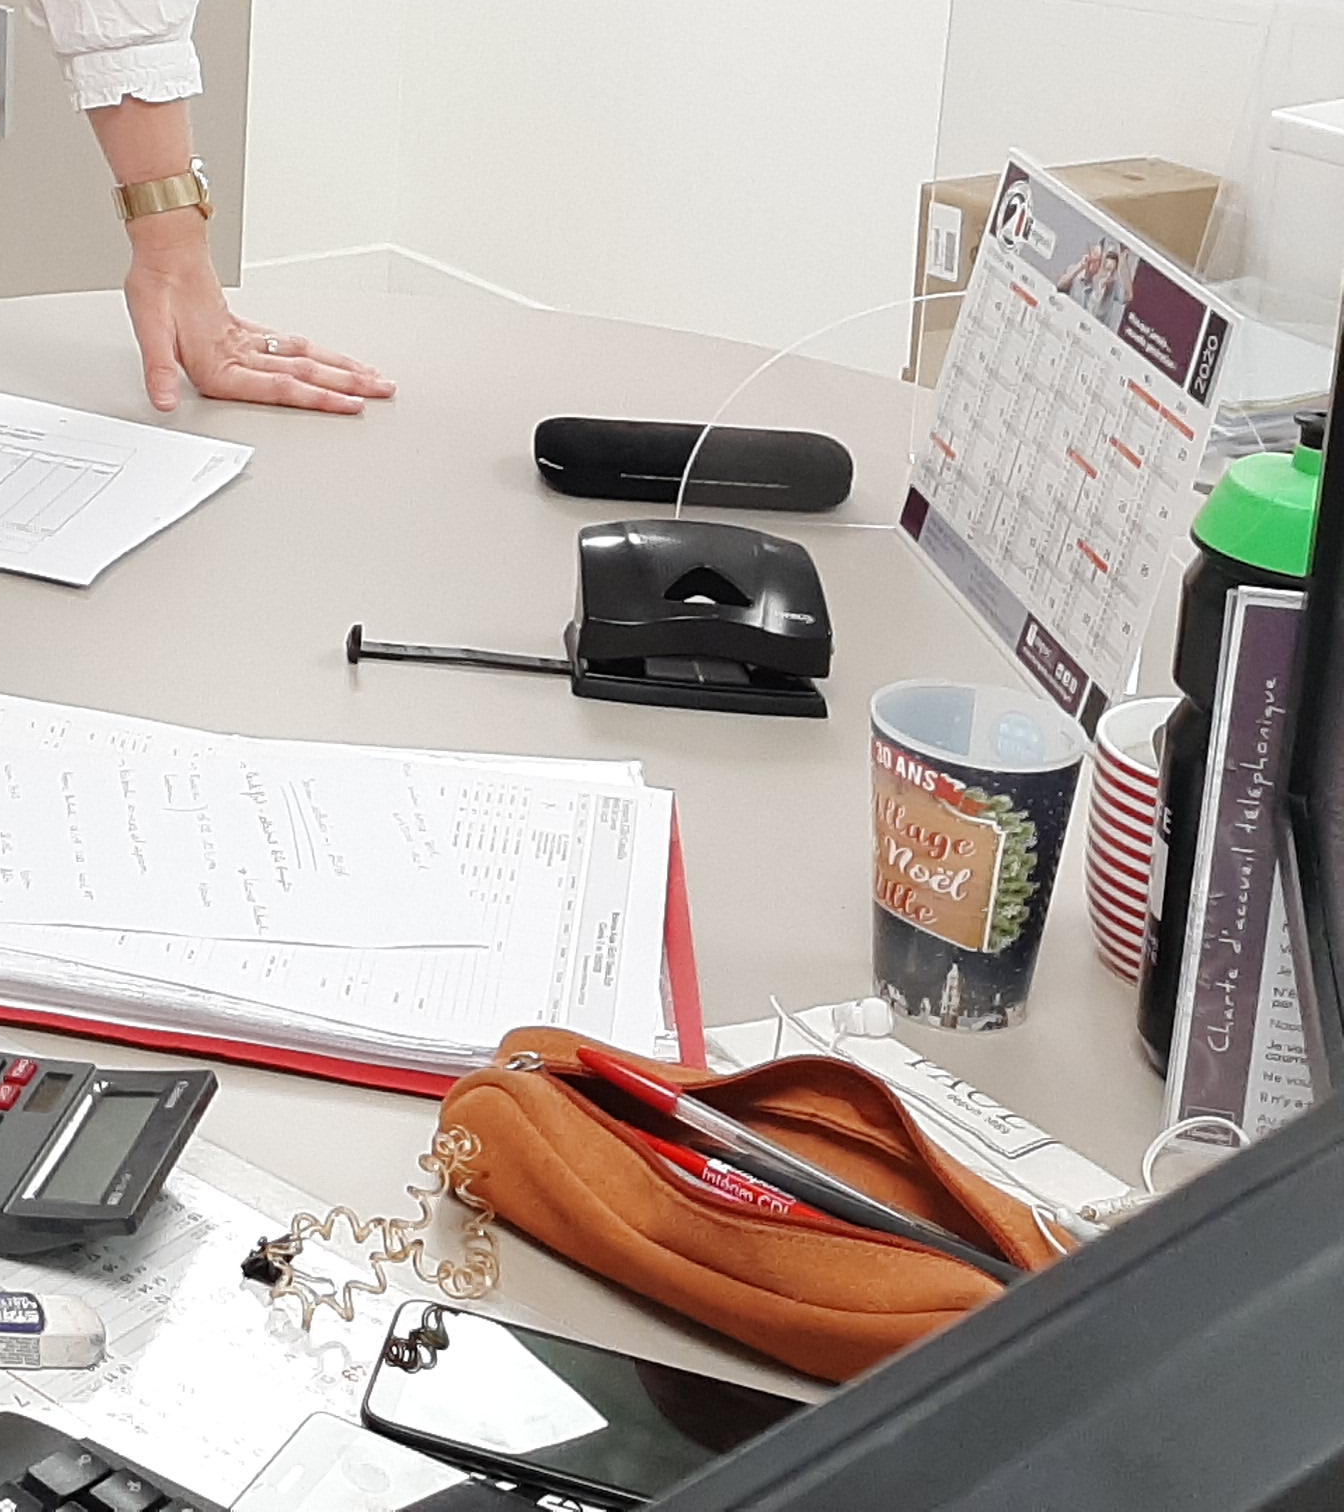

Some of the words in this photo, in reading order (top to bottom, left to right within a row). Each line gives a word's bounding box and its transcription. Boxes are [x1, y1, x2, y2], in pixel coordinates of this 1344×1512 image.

[1194, 335, 1219, 394] 2020
[895, 756, 938, 791] ANS
[1218, 846, 1256, 954] d'accueil
[1207, 967, 1239, 1052] Charte
